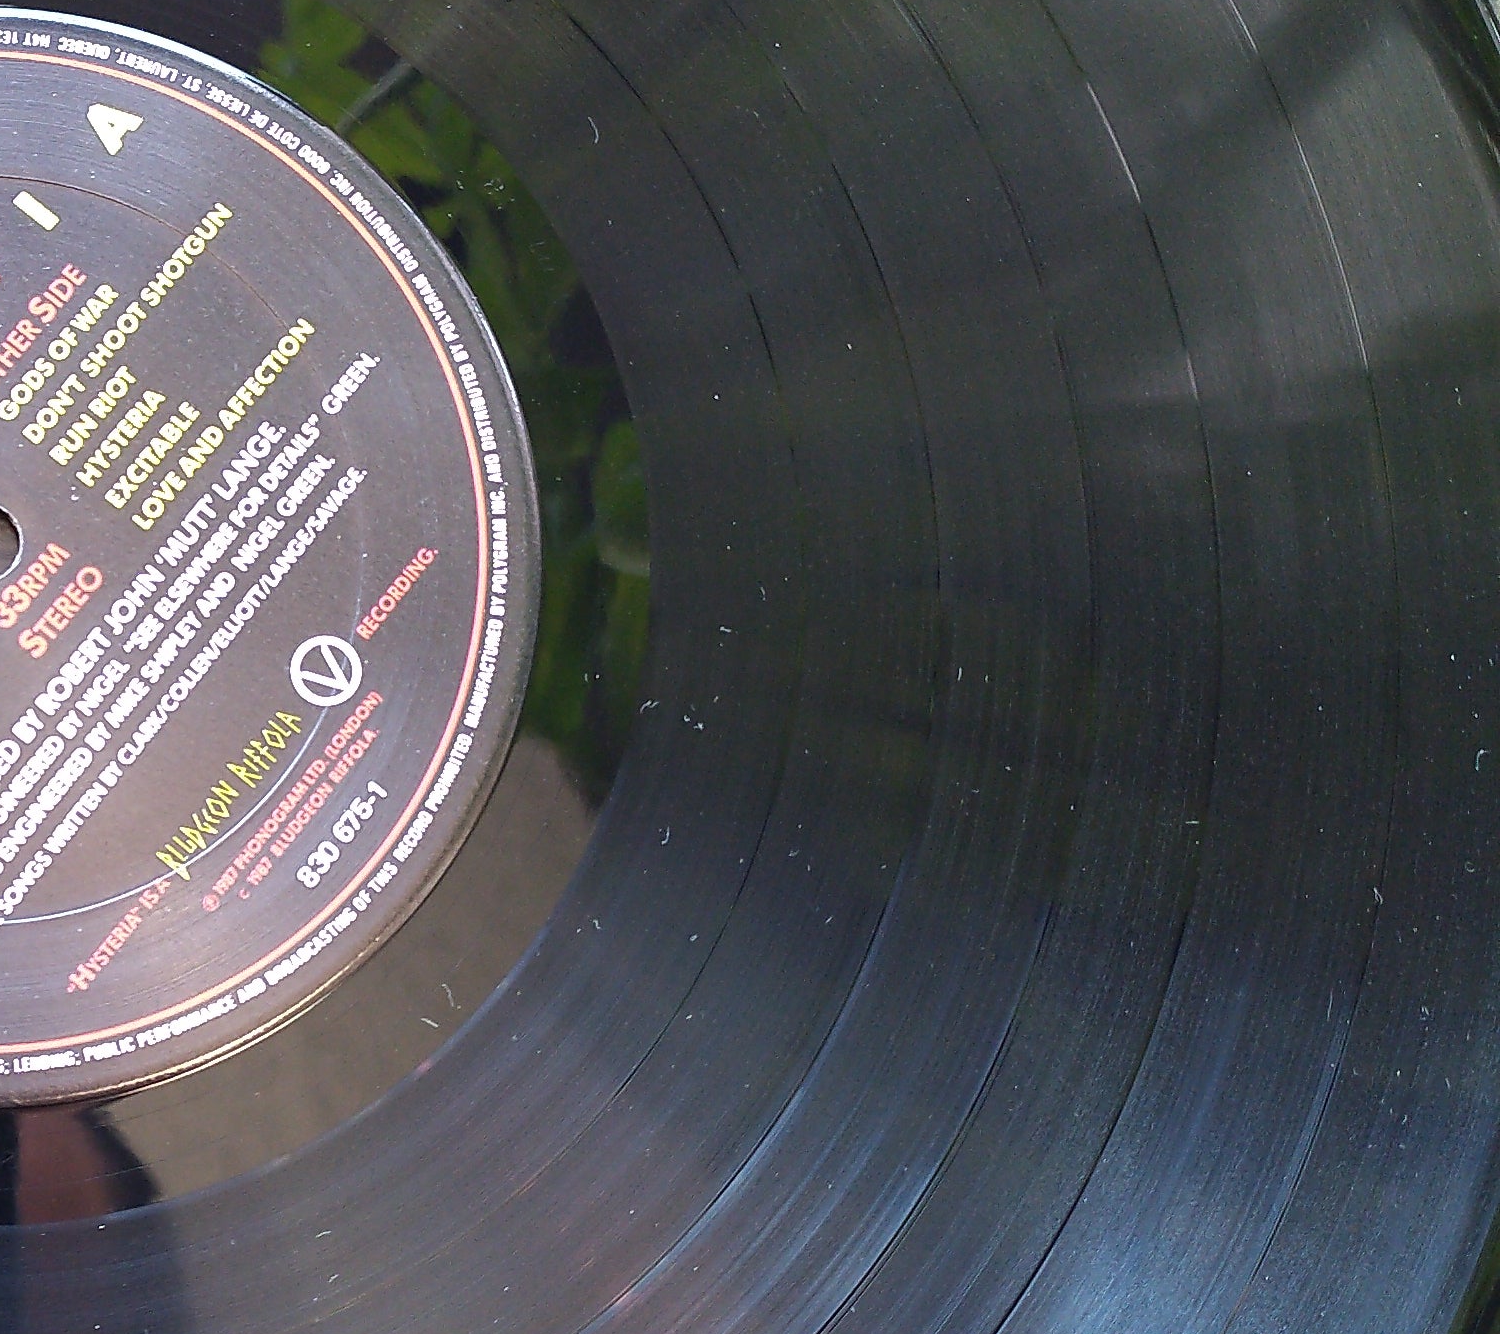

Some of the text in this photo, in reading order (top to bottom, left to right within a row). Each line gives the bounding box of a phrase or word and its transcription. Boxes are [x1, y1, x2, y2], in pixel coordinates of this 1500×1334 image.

[21, 202, 232, 444] DON'T SHOOT SHOTGUN
[27, 263, 86, 326] SIDE
[48, 326, 77, 360] OF
[69, 284, 118, 331] WAR
[411, 273, 459, 342] POLYGRAM
[448, 343, 469, 362] BY
[48, 365, 136, 465] RUN RIOT
[75, 390, 165, 486] HYSTERIA
[104, 401, 199, 508] EXCITABLE
[131, 318, 314, 529] LOVE AND AFFECTION
[483, 453, 503, 482] AND
[11, 708, 44, 743] BY
[34, 626, 111, 715] ROBERT
[103, 564, 165, 635] JOHN
[211, 421, 286, 500] LANGE.
[56, 709, 83, 739] BY
[74, 659, 130, 716] NIGEL
[153, 522, 238, 620] ELSEWHERE
[228, 486, 268, 528] FOR
[321, 352, 380, 414] GREEN.
[17, 566, 102, 658] STEREO
[84, 721, 111, 751] BY
[103, 677, 150, 728] MIKE
[140, 610, 201, 683] SHIPLEY
[195, 571, 235, 617] AND
[230, 515, 285, 571] NIGEL
[276, 454, 335, 516] GREEN.
[355, 547, 438, 639] RECORDING.
[226, 711, 301, 787] RIFFOLA
[42, 781, 108, 853] WRITTEN
[98, 760, 122, 786] BY
[233, 781, 308, 869] PHONOGRAM
[246, 855, 272, 885] 1987
[269, 782, 333, 857] BLUDGEON
[296, 780, 387, 887] 830 675-1
